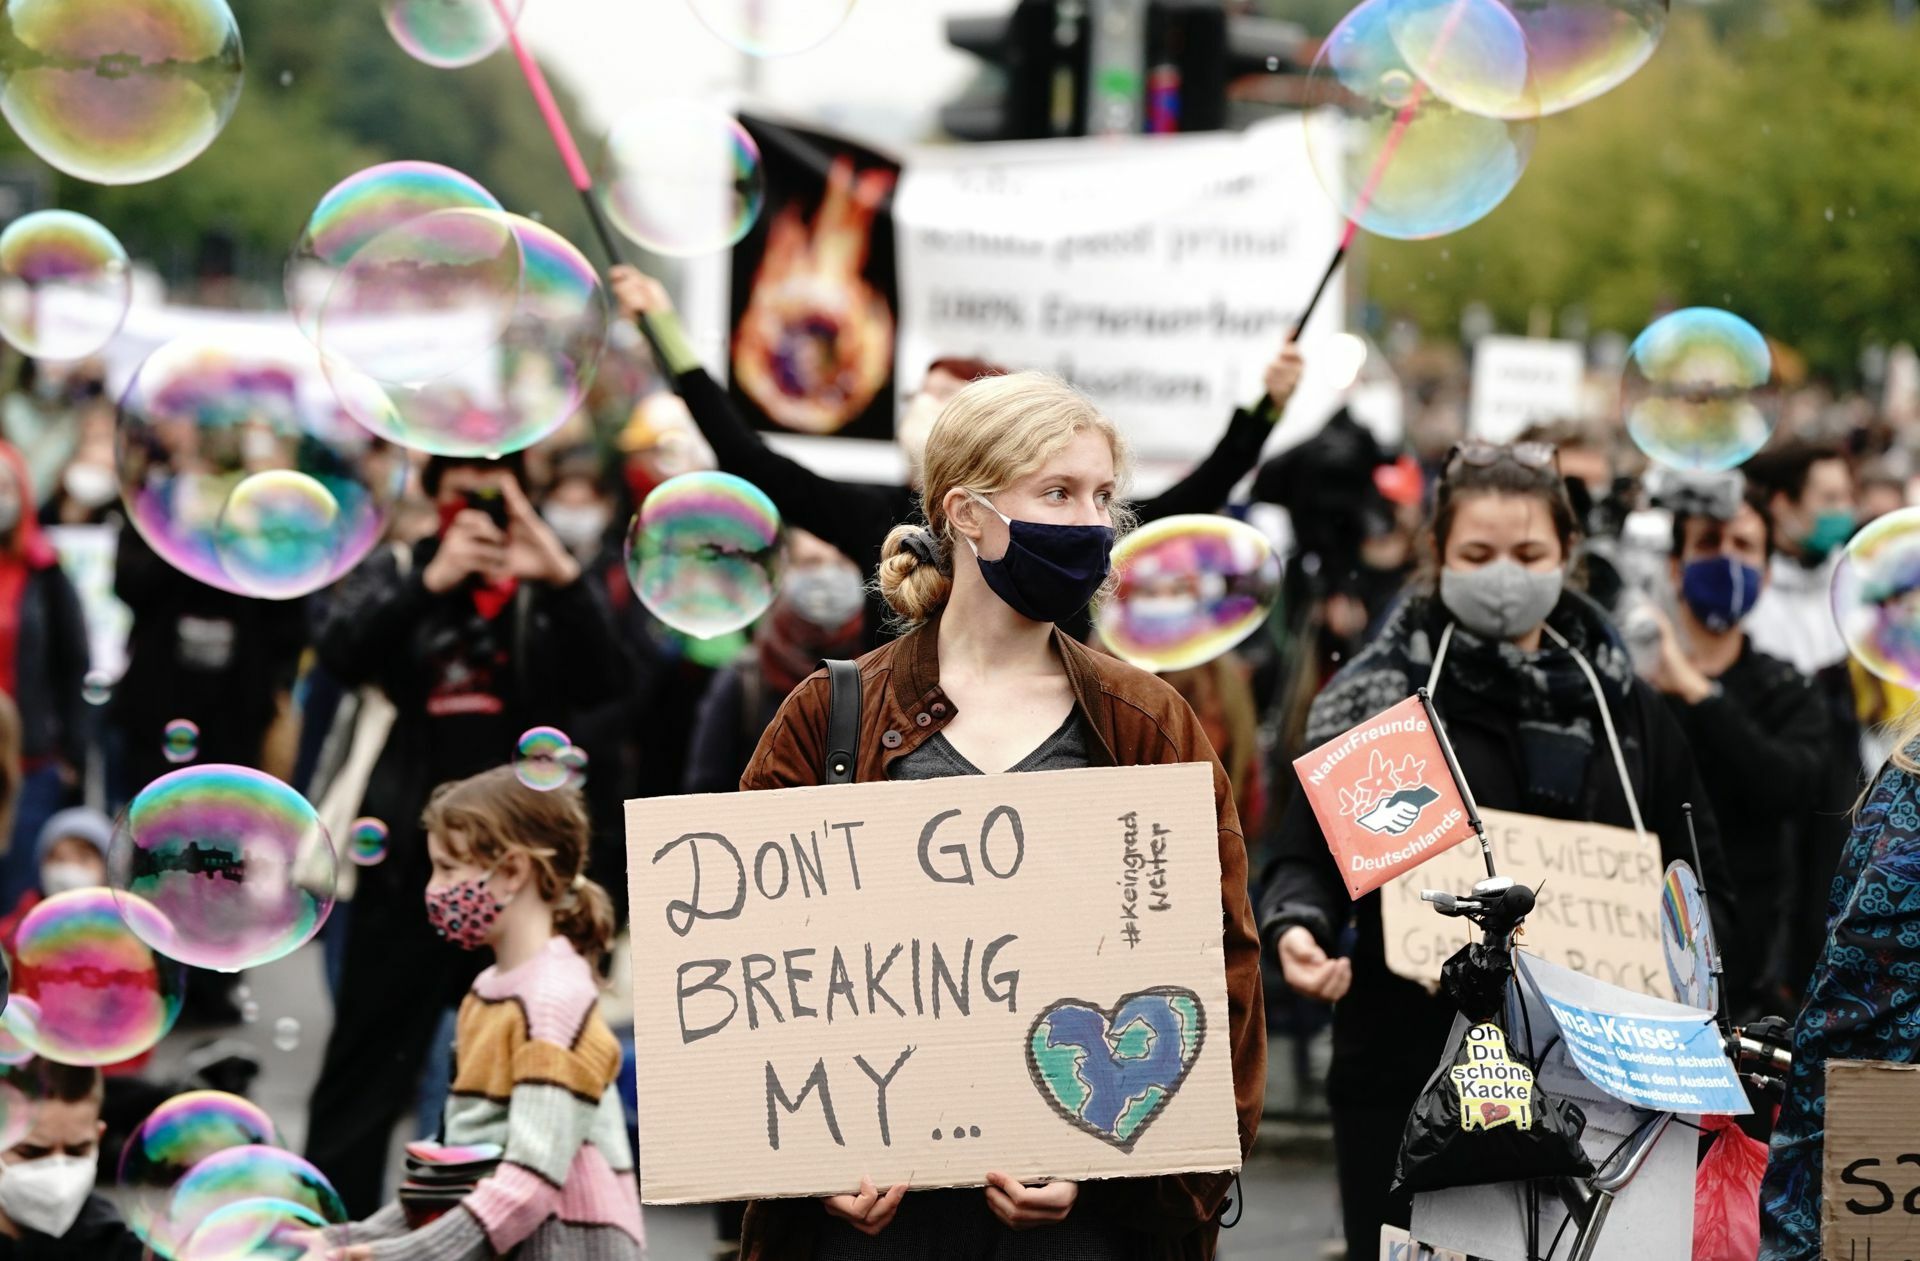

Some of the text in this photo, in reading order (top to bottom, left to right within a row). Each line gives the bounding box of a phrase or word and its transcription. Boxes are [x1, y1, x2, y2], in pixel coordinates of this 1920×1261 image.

[1308, 716, 1427, 786] NaturFreunde
[1352, 807, 1462, 872] Deutschlands
[652, 805, 1025, 937] DON'T GO
[1535, 835, 1660, 888] WIEDER
[1536, 888, 1660, 943] RETTEN
[677, 934, 1020, 1044] BREAKING
[1468, 1026, 1501, 1042] Oh
[1472, 1045, 1504, 1061] Du
[1453, 1062, 1532, 1082] schöne
[1615, 1046, 1675, 1068] Überleben
[1676, 1054, 1728, 1069] sichern!
[1461, 1080, 1529, 1100] Kacke
[1629, 1070, 1651, 1085] aus
[1651, 1073, 1678, 1088] dem
[1680, 1074, 1734, 1089] Ausland.
